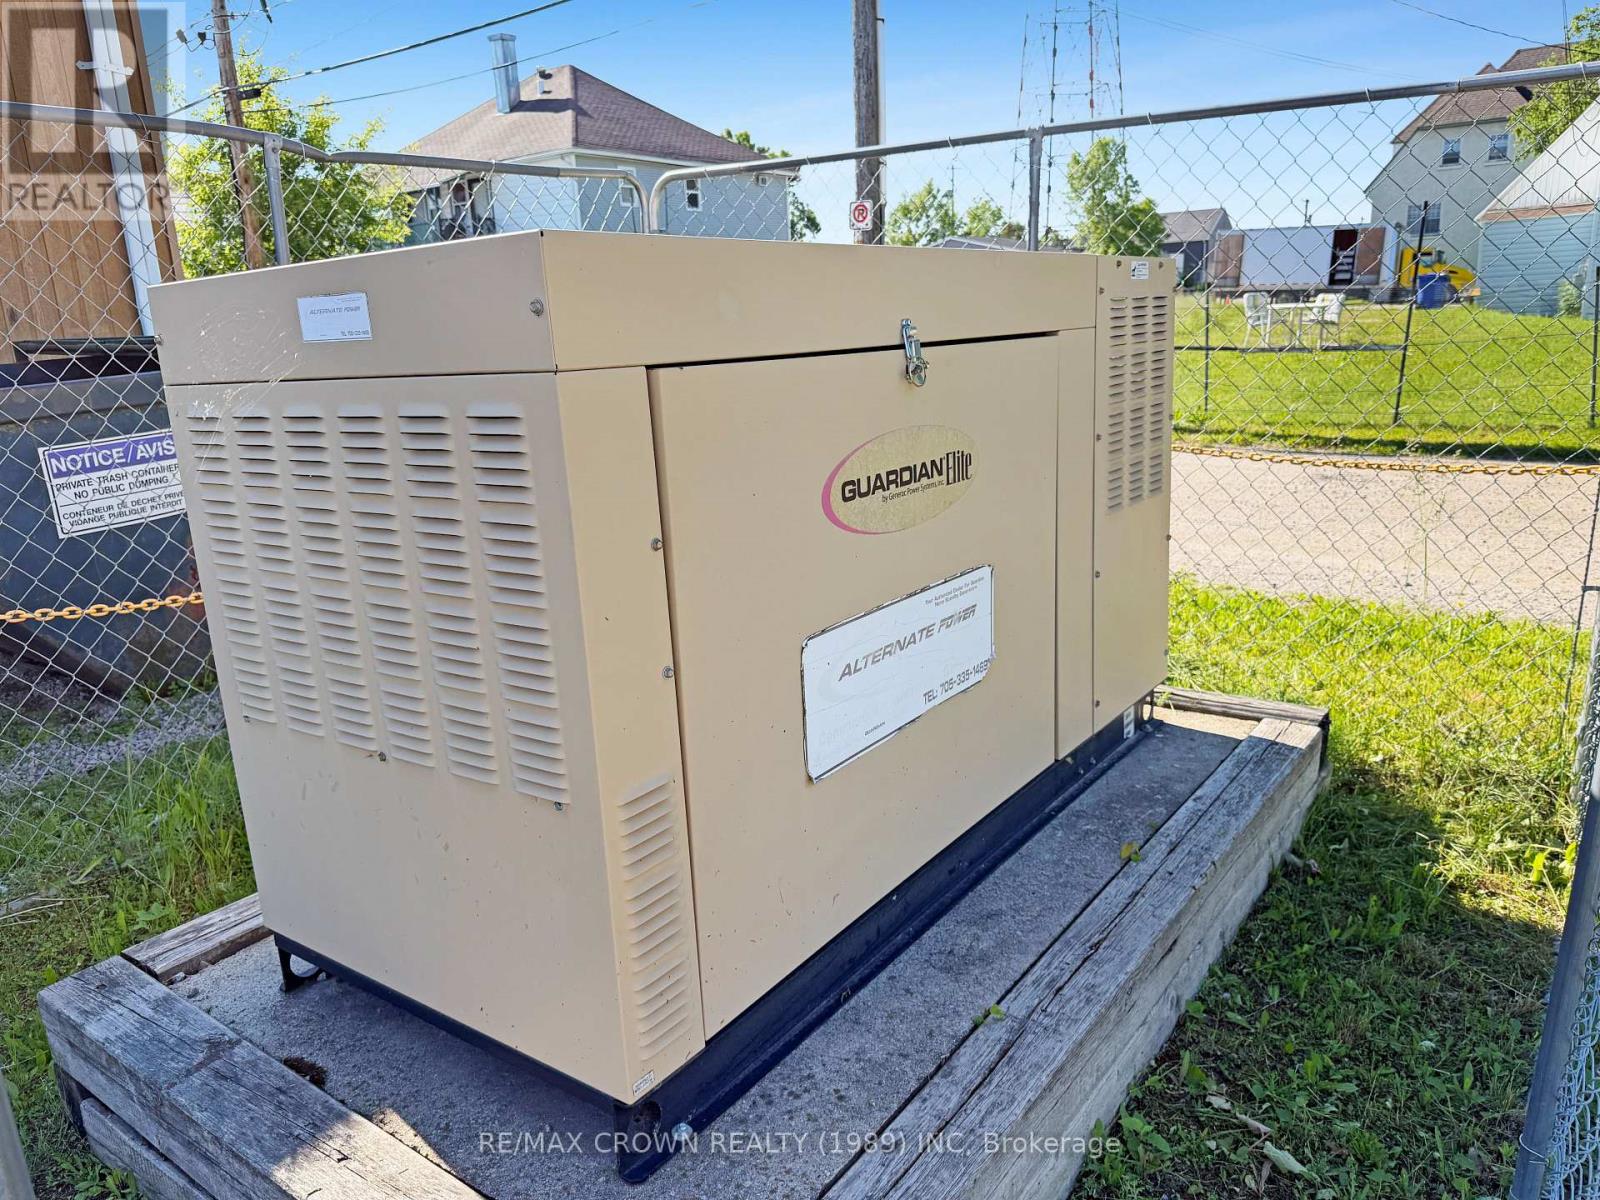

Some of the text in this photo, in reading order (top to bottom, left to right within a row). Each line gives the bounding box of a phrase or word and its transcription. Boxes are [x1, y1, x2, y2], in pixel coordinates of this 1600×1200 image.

[56, 478, 96, 492] PRIVATE
[97, 473, 128, 484] TRASH
[74, 475, 169, 500] NO PUBLIC DUMPING
[841, 449, 972, 503] GUARDIAN Elite
[62, 504, 114, 520] CONTENEUR
[117, 502, 128, 511] DE
[69, 499, 182, 527] VIDANGE PUBLIQUE INTERDIT
[838, 604, 978, 682] ALTERNATE POWER
